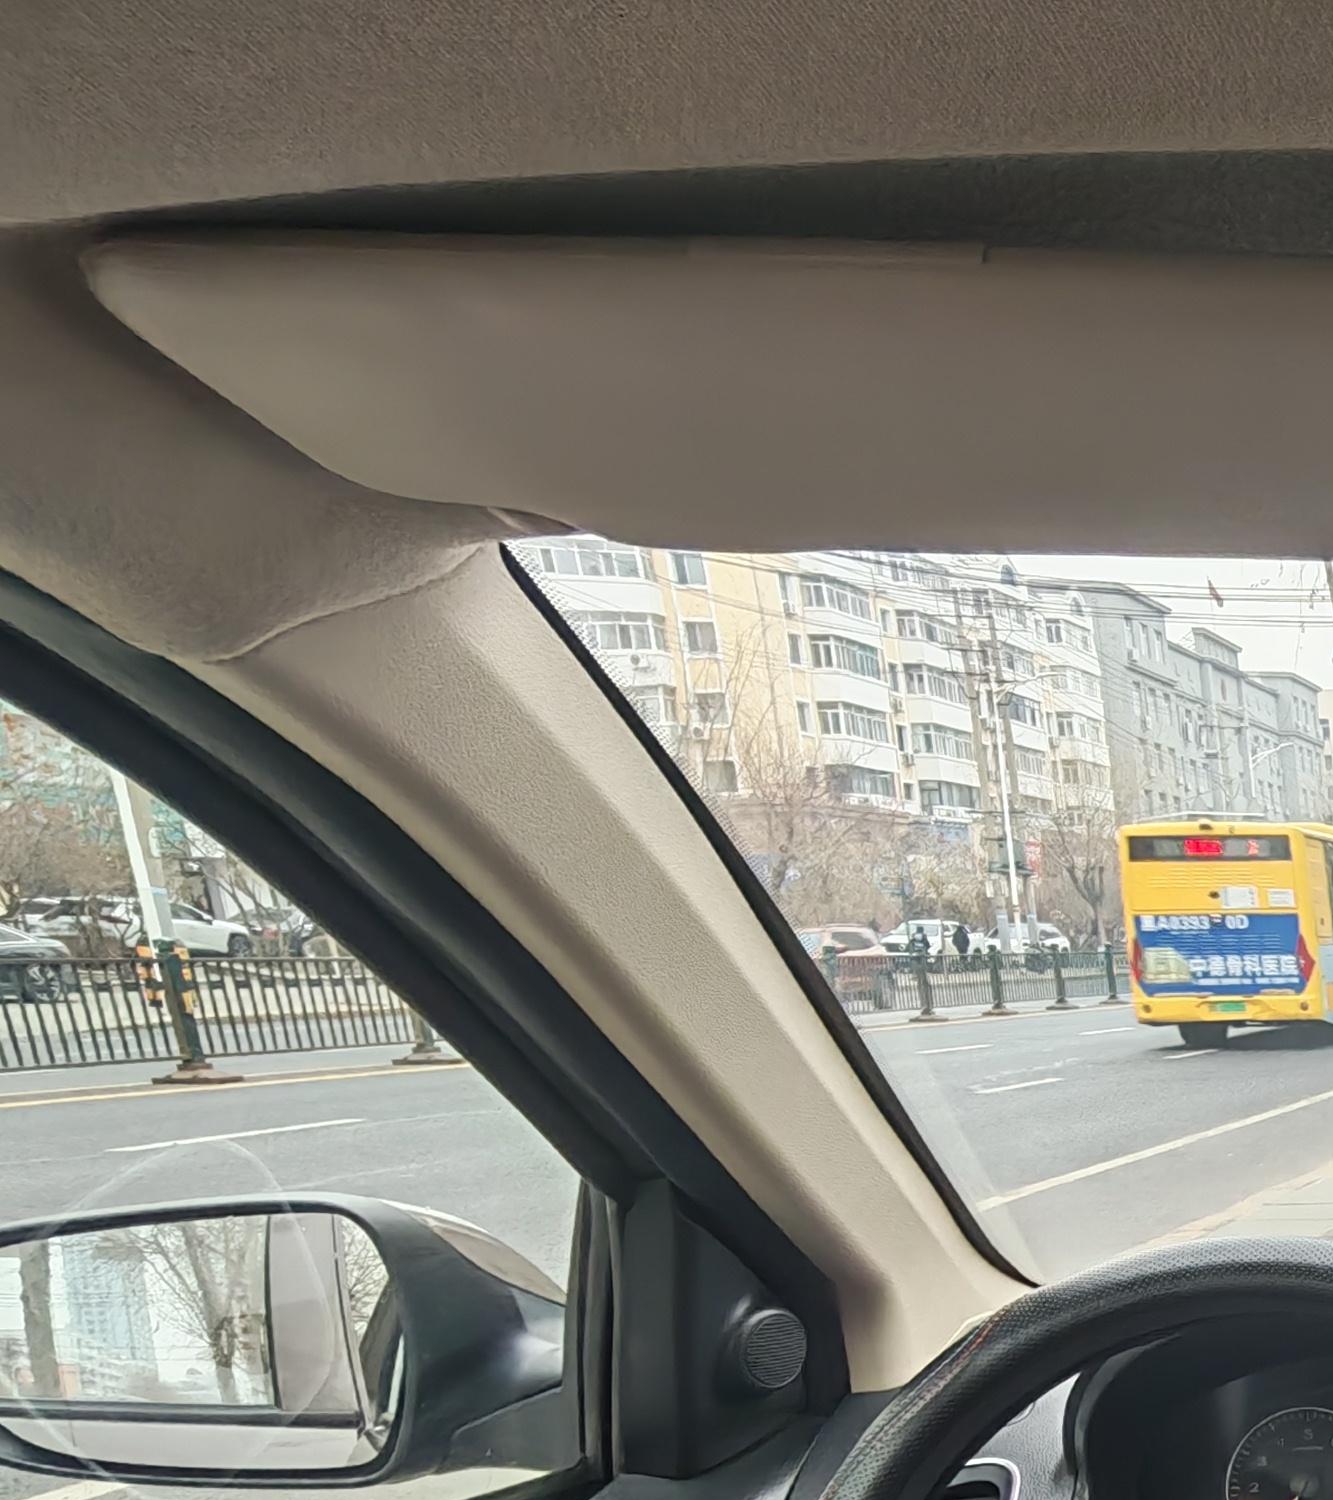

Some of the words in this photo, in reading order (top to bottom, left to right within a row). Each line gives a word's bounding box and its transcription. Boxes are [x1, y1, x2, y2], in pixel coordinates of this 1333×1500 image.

[1189, 954, 1299, 977] 中德骨科医院
[1257, 1455, 1267, 1467] 3
[1250, 1482, 1260, 1493] 2
